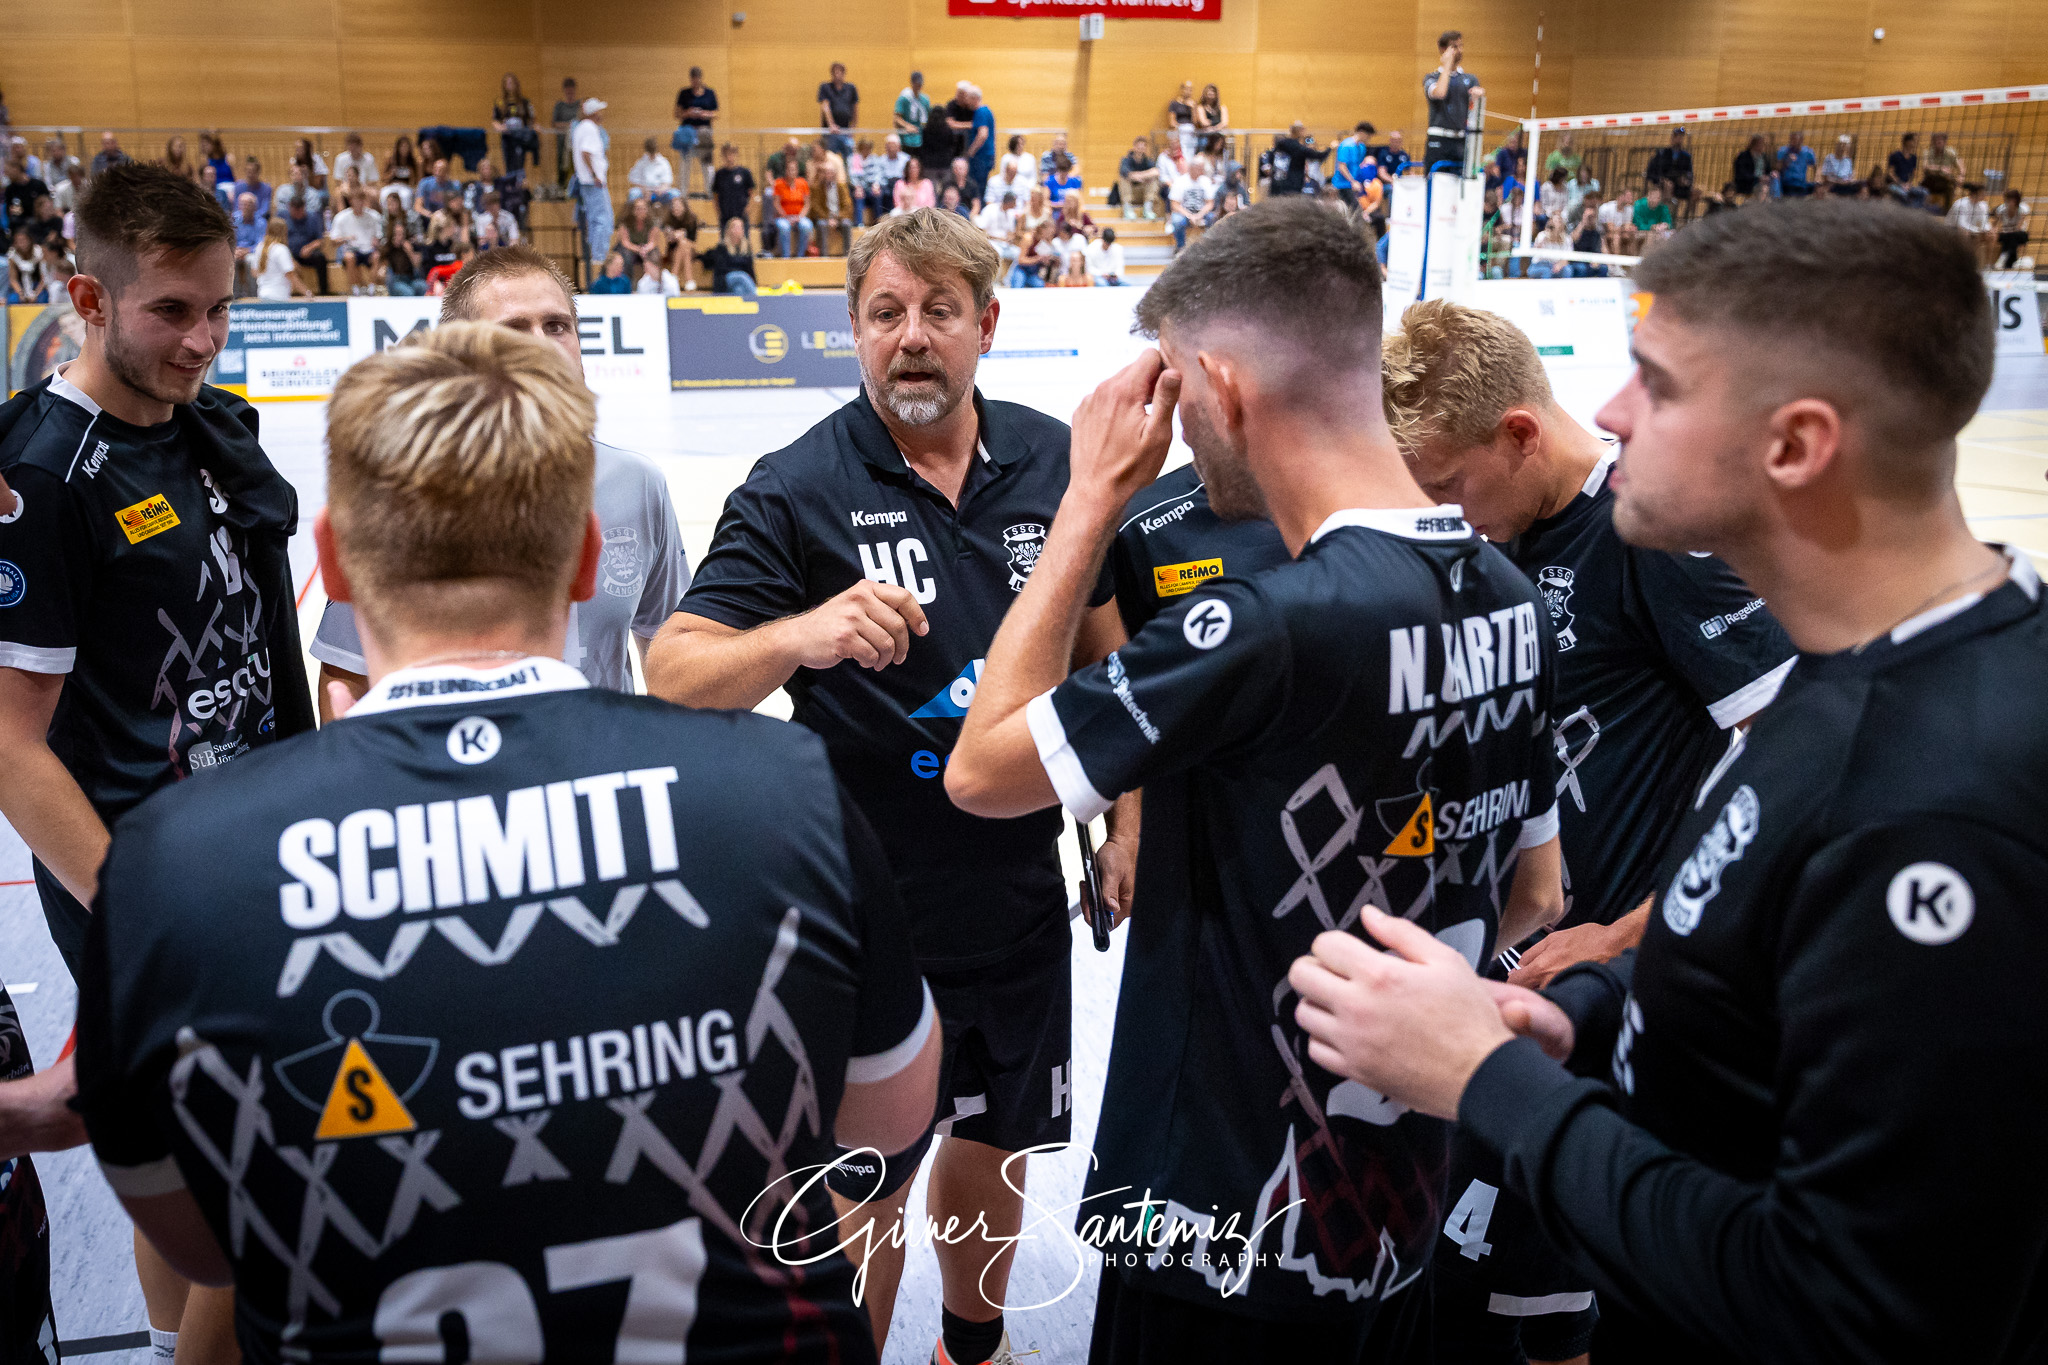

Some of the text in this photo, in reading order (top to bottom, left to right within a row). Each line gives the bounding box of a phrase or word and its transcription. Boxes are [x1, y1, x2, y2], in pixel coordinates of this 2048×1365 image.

[81, 440, 110, 480] Kempa
[850, 510, 908, 528] Kempa
[1011, 525, 1035, 536] SSG
[1139, 499, 1195, 535] Kempa
[857, 537, 938, 605] HC
[1548, 568, 1571, 580] SSG
[1724, 597, 1766, 625] Regeltec
[1388, 624, 1436, 715] N.
[189, 749, 217, 770] StB
[1411, 779, 1531, 848] S SEHRIN
[278, 765, 679, 930] SCHMITT
[346, 1009, 739, 1123] S SEHRING
[834, 1162, 876, 1177] empa
[1443, 1178, 1499, 1261] 4
